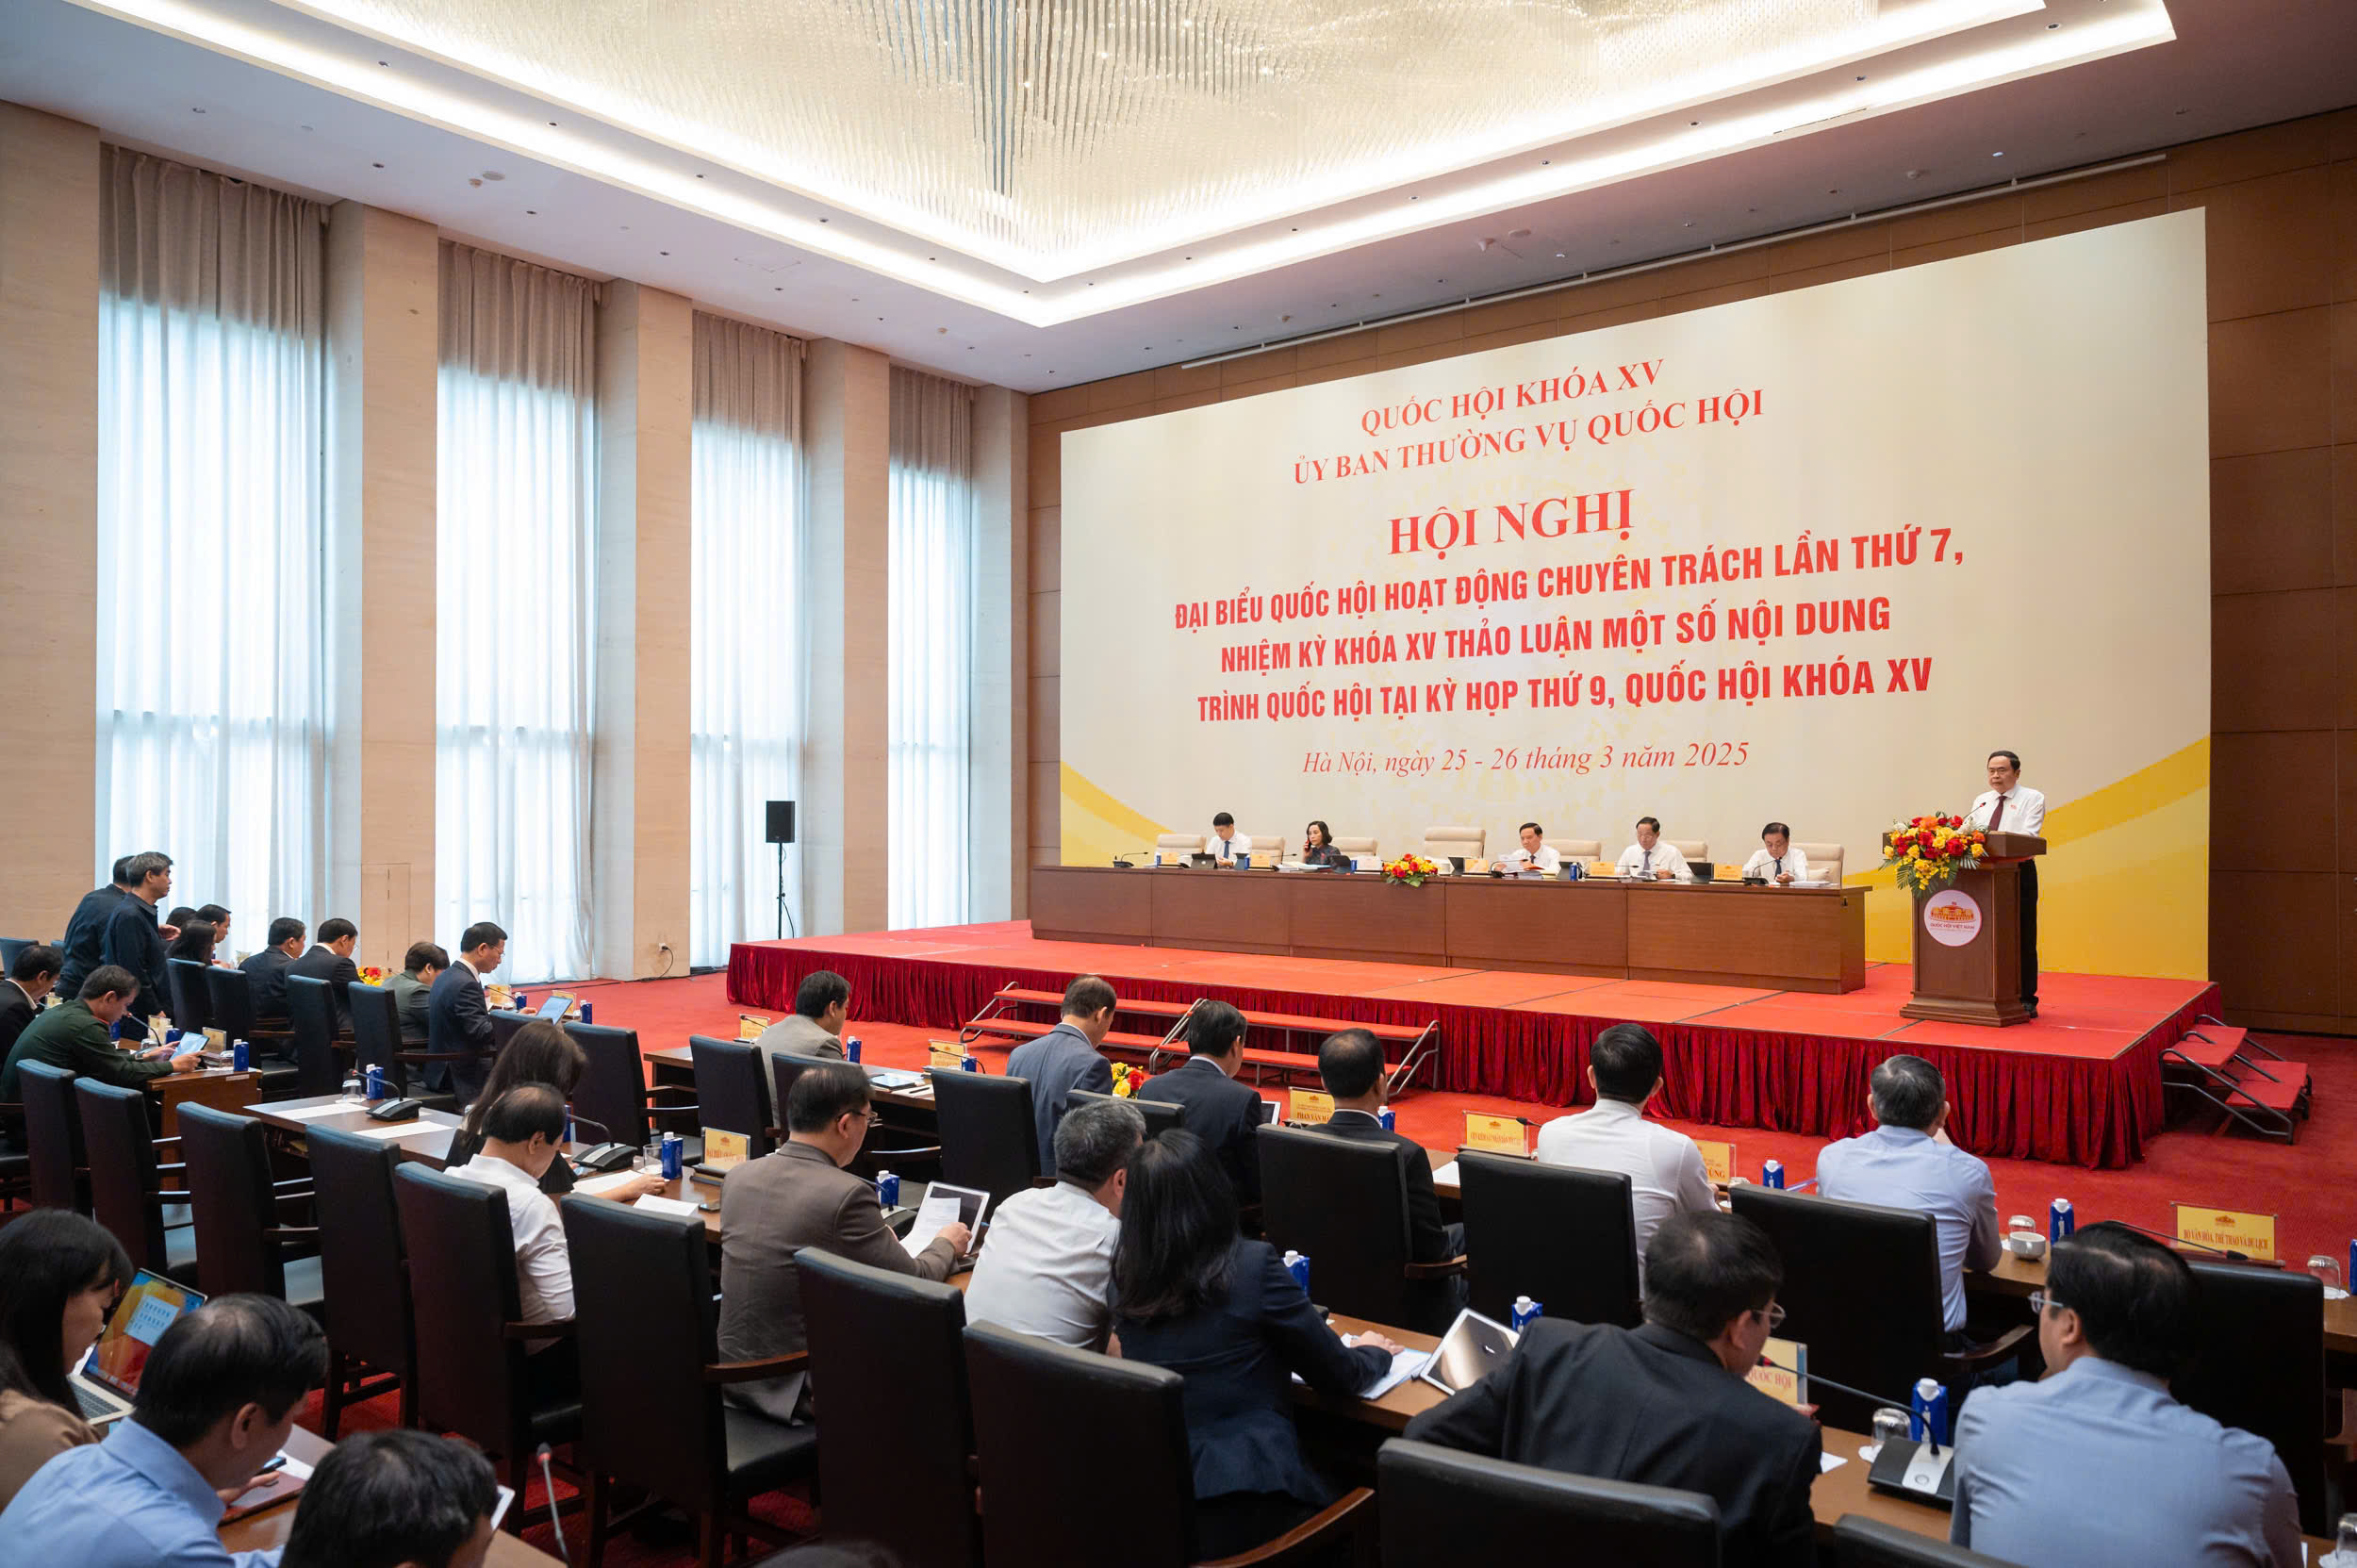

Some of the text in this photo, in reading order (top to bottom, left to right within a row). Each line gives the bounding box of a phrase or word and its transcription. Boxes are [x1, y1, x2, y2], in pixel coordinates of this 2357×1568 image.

[1294, 388, 1763, 485] ỦY BAN THƯỜNG VỤ QUỐC HỘI
[1360, 358, 1665, 437] QUỐC HỘI KHÓA XV
[1387, 488, 1637, 561] HỘI NGHỊ
[1174, 522, 1964, 635] ĐẠI BIỂU QUỐC HỘI HOẠT ĐỘNG CHUYÊN TRÁCH LẦN THỨ 7,
[1221, 595, 1890, 677] NHIỆM KỲ KHÓA XV THẢO LUẬN MỘT SỐ NỘI DUNG
[1196, 653, 1933, 722] TRÌNH QUỐC HỘI TẠI KỲ HỌP THỨ 9, QUỐC HỘI KHÓA XV
[1302, 751, 1333, 774] Hà
[1336, 751, 1377, 778] Nội,
[1384, 749, 1436, 778] ngày
[1441, 748, 1468, 772] 25
[1490, 747, 1519, 770] 26
[1524, 746, 1592, 777] tháng
[1598, 744, 1614, 769] 3
[1621, 745, 1675, 768] năm
[1682, 740, 1751, 767] 2025
